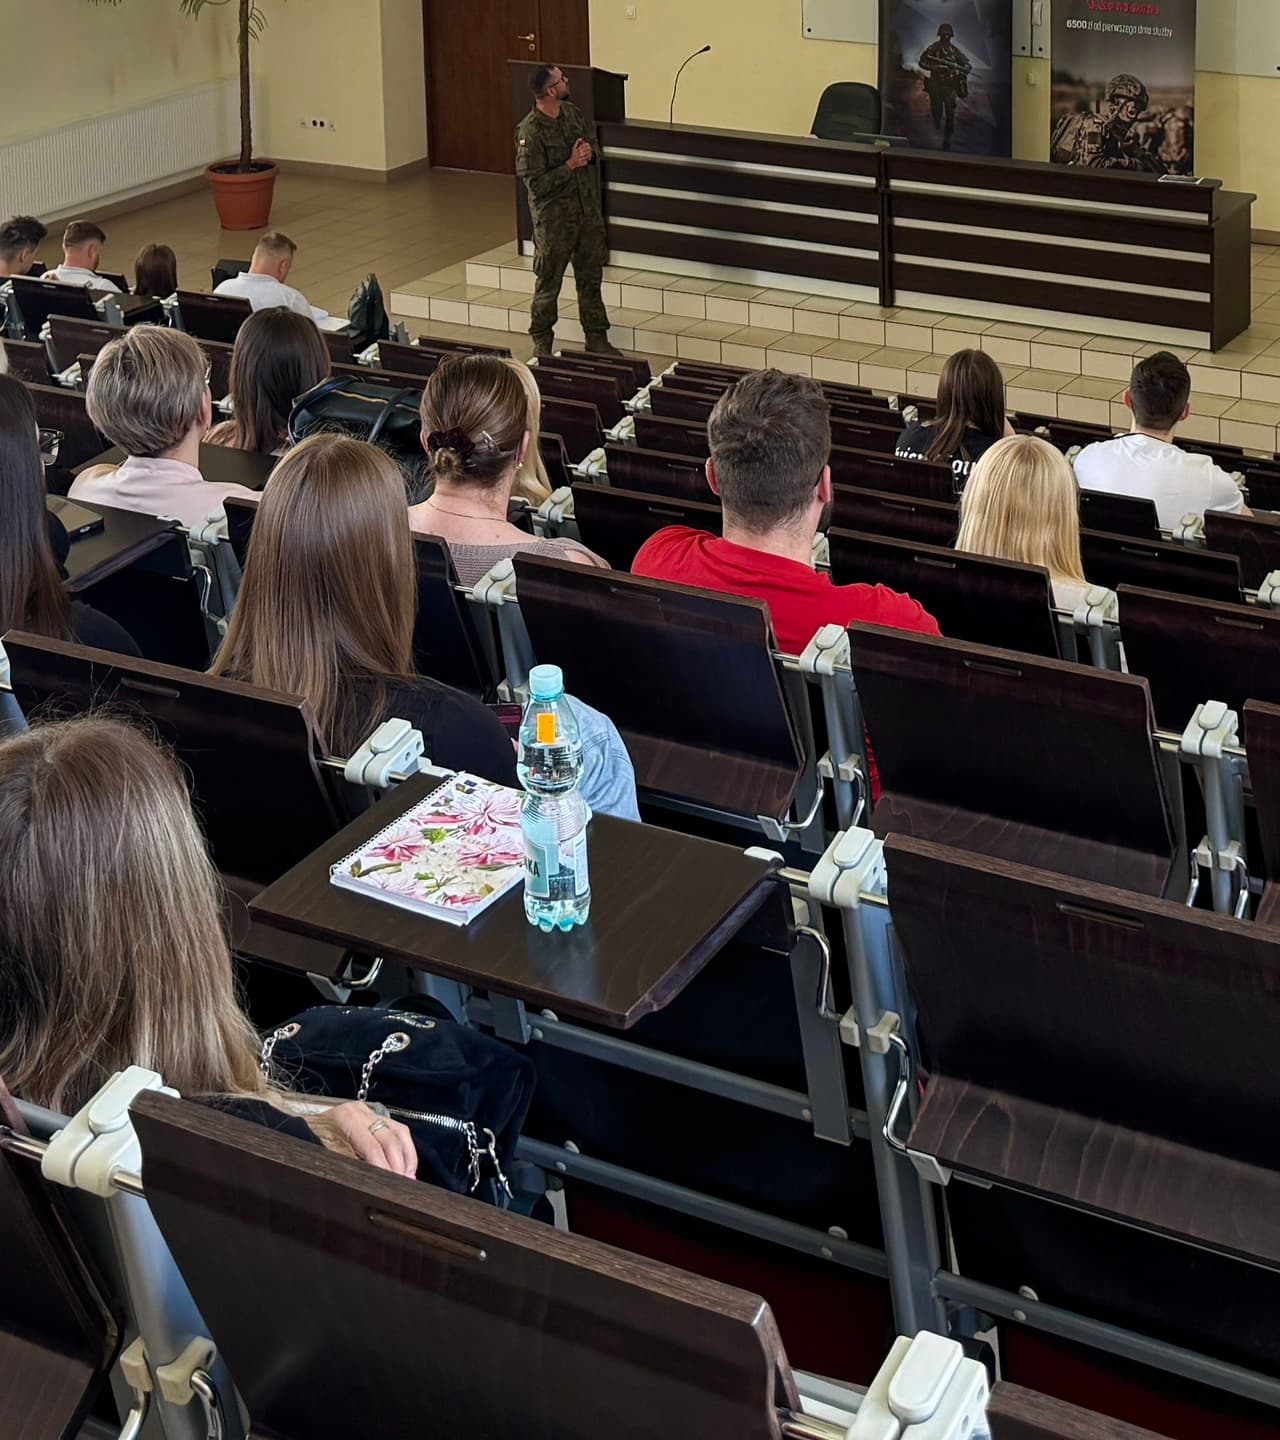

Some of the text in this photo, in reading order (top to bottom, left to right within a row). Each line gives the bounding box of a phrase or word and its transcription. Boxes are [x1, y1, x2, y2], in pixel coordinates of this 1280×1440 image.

[1066, 19, 1087, 29] 6500
[1093, 20, 1101, 32] od
[1102, 21, 1137, 36] pierwszego
